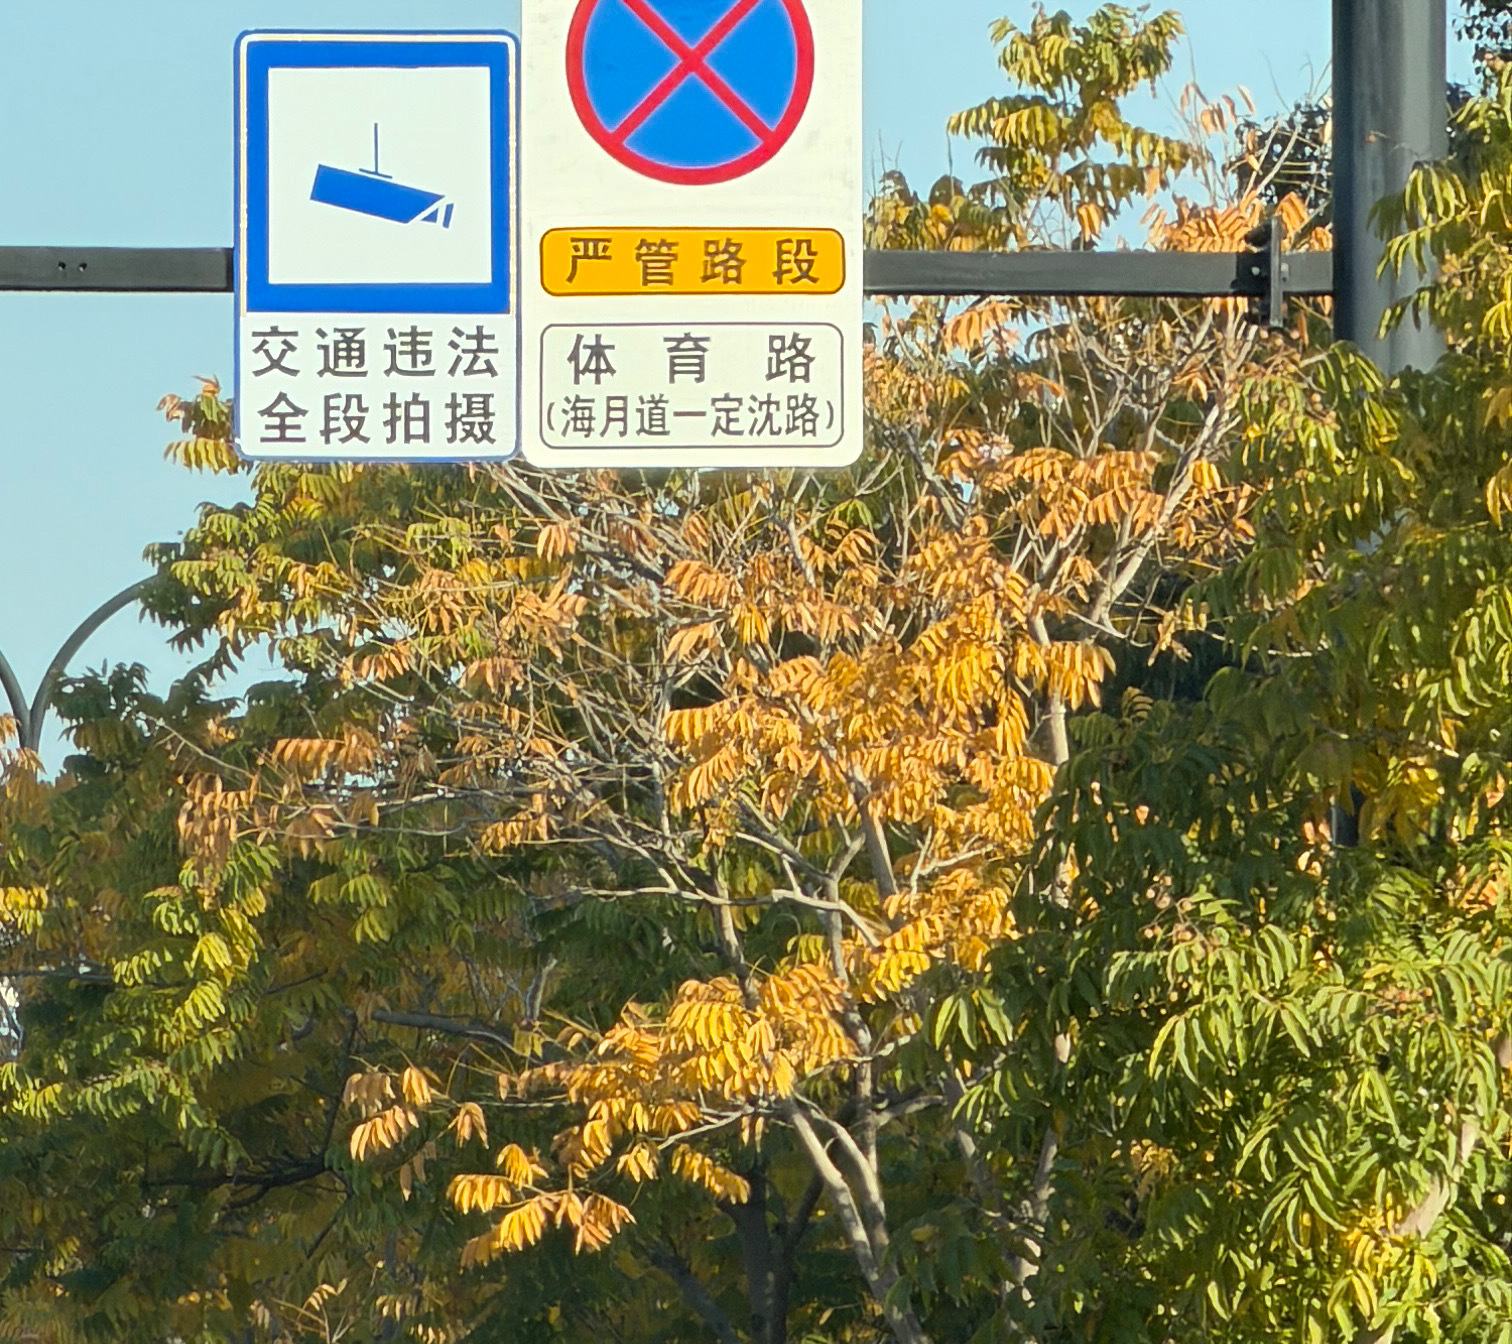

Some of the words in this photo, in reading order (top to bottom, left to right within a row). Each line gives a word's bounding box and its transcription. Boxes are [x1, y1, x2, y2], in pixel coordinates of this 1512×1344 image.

[565, 237, 819, 287] 严管路段
[251, 325, 499, 378] 交通违法
[567, 332, 816, 384] 体育路
[257, 391, 497, 444] 全段拍摄
